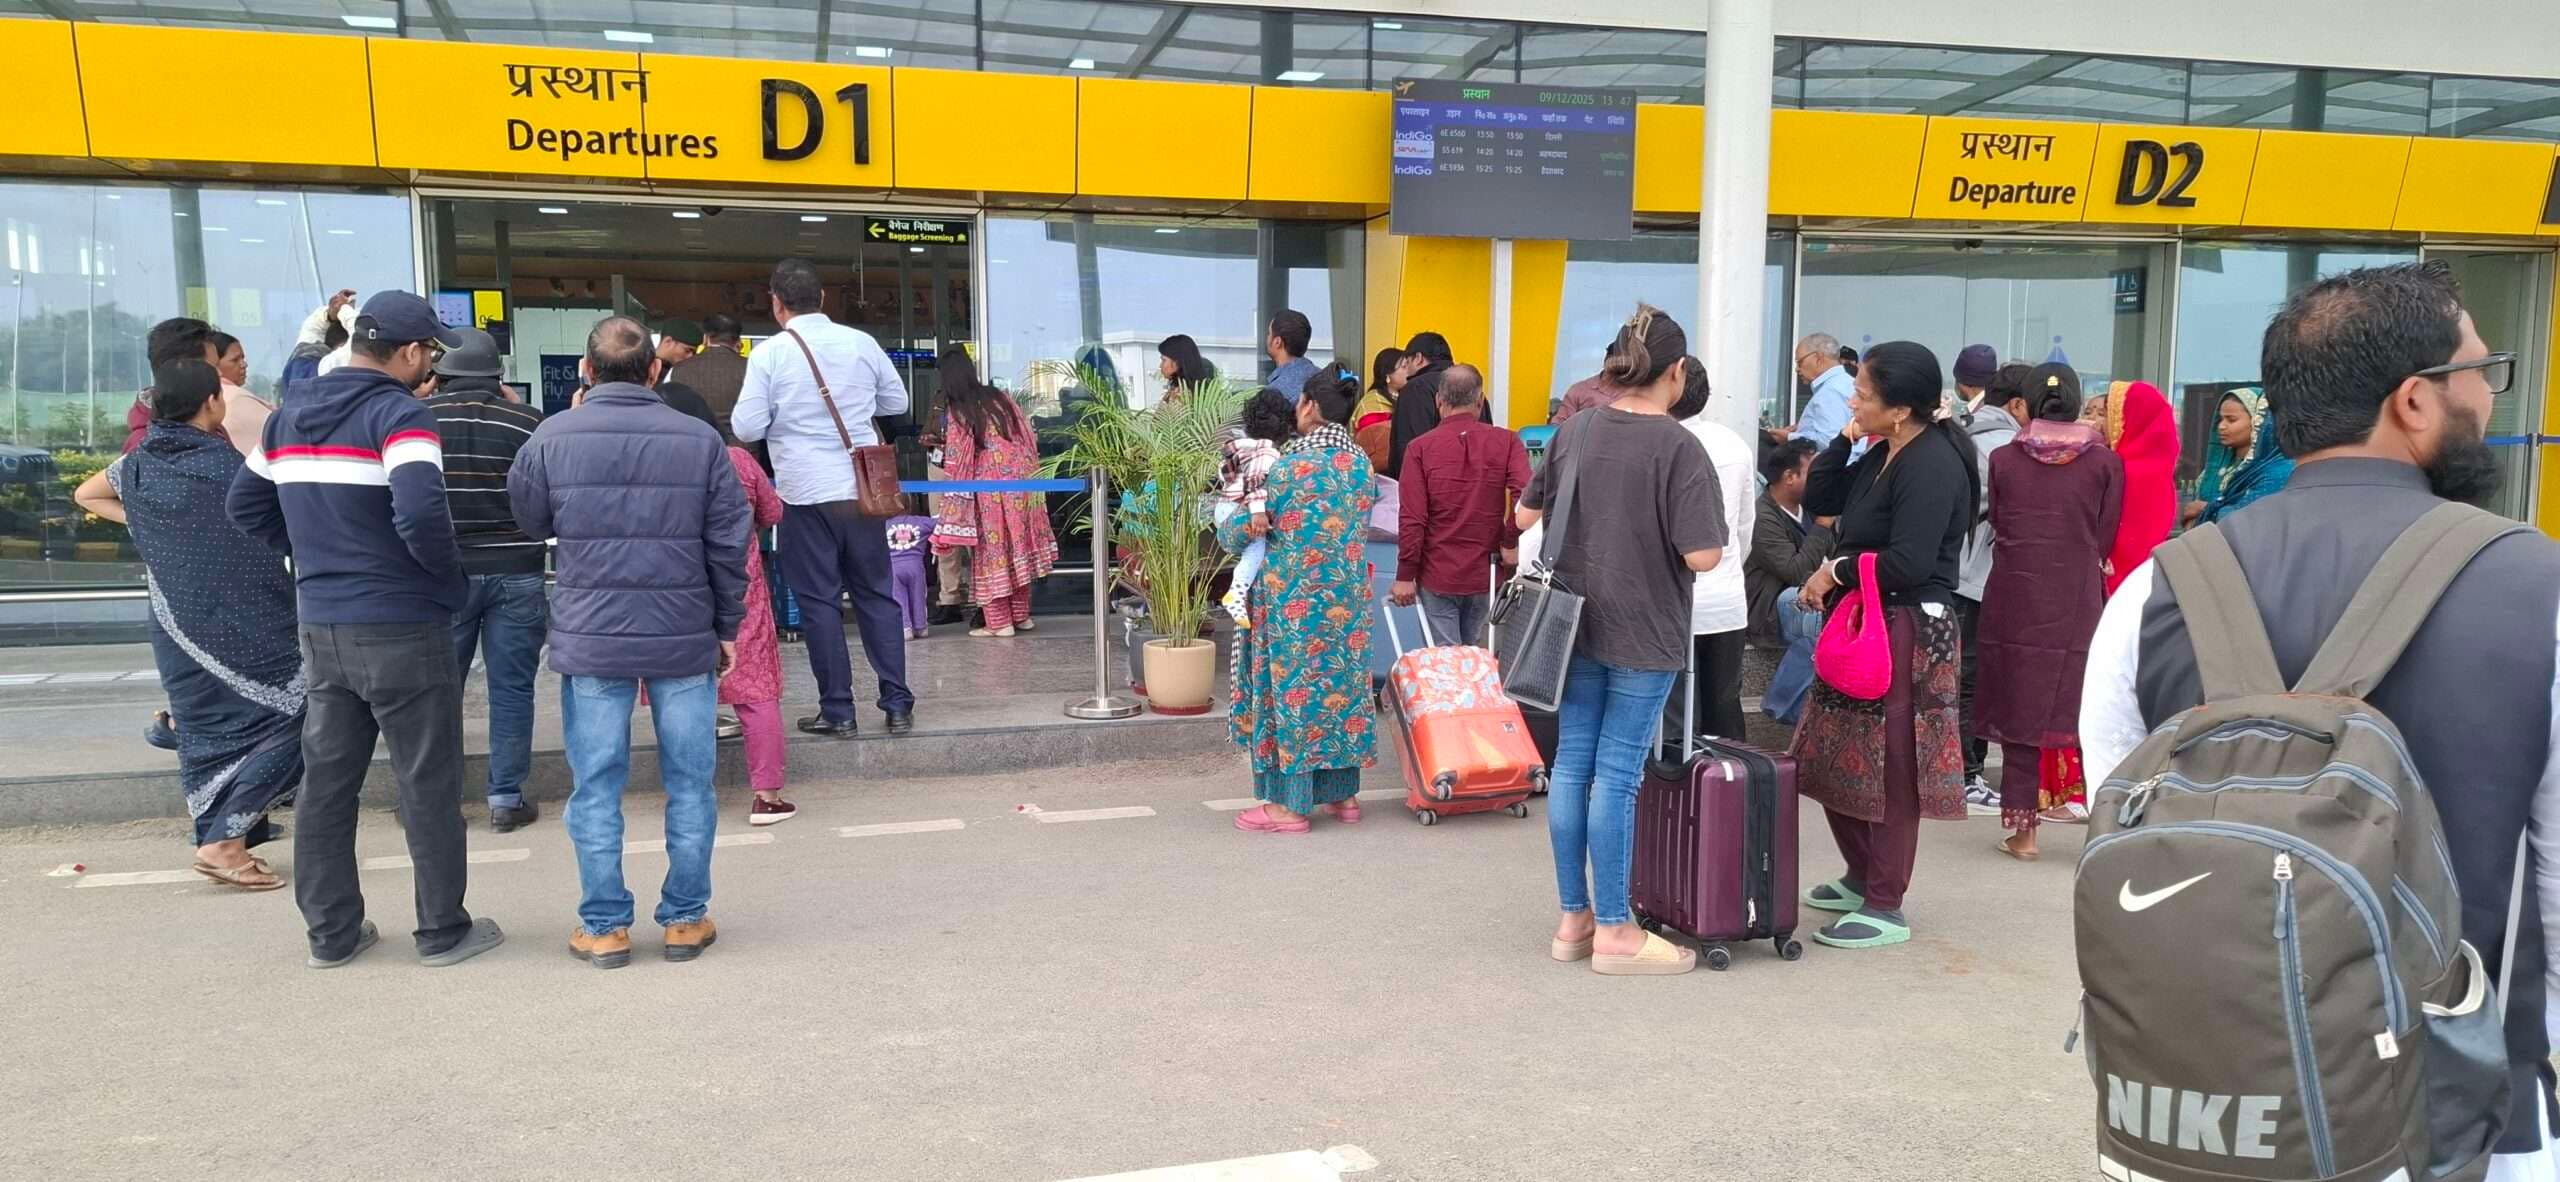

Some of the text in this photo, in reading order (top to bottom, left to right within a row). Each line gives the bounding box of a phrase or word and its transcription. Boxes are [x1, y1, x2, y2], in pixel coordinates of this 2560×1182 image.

[503, 63, 651, 102] प्रस्थान
[1539, 92, 1595, 105] 09/12/2025
[760, 78, 871, 165] D1
[1395, 130, 1433, 141] IndiGo
[506, 118, 718, 161] Departures
[1960, 132, 2056, 161] प्रस्थान
[1394, 164, 1433, 176] IndiGo
[2115, 139, 2205, 208] D2
[1949, 176, 2076, 210] Departure
[888, 232, 954, 243] Baggage Screening
[2106, 1073, 2282, 1160] NIKE
